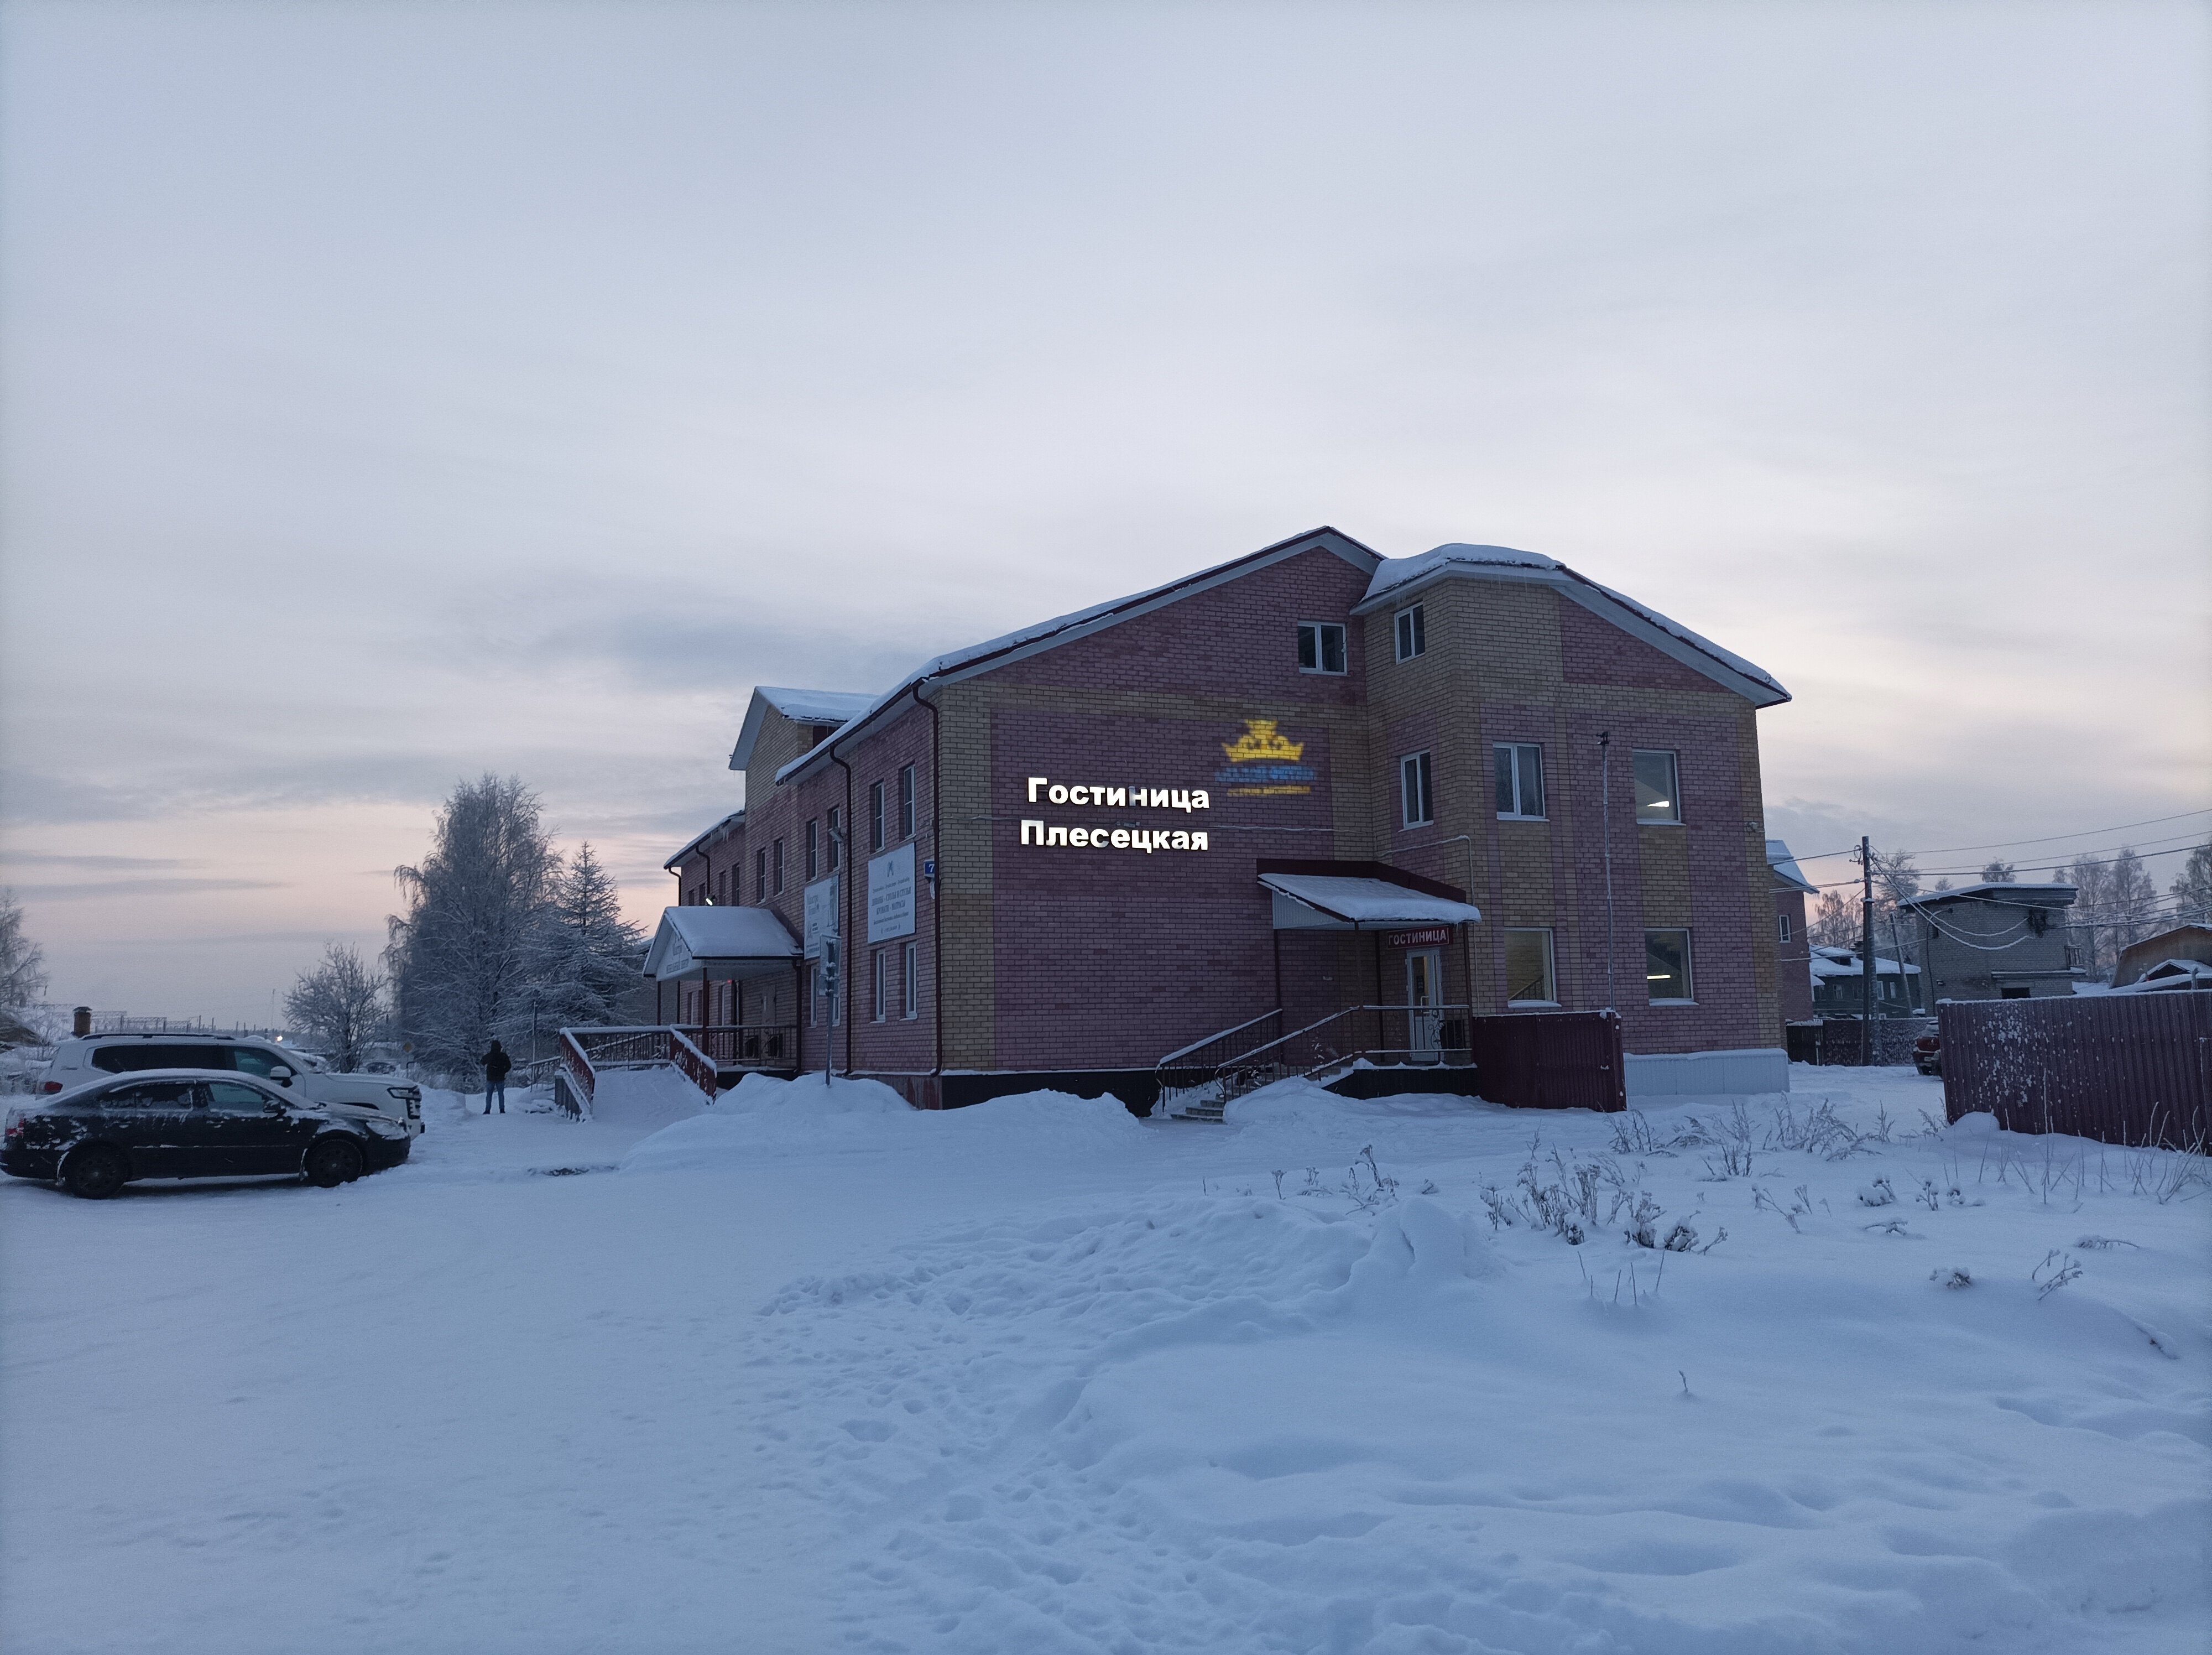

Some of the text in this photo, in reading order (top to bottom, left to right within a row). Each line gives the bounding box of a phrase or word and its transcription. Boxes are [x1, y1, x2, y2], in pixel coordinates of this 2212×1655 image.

[1028, 777, 1210, 813] Гостиница
[1020, 819, 1209, 853] Плесецкая
[1388, 929, 1447, 946] ГОСТИНИЦА
